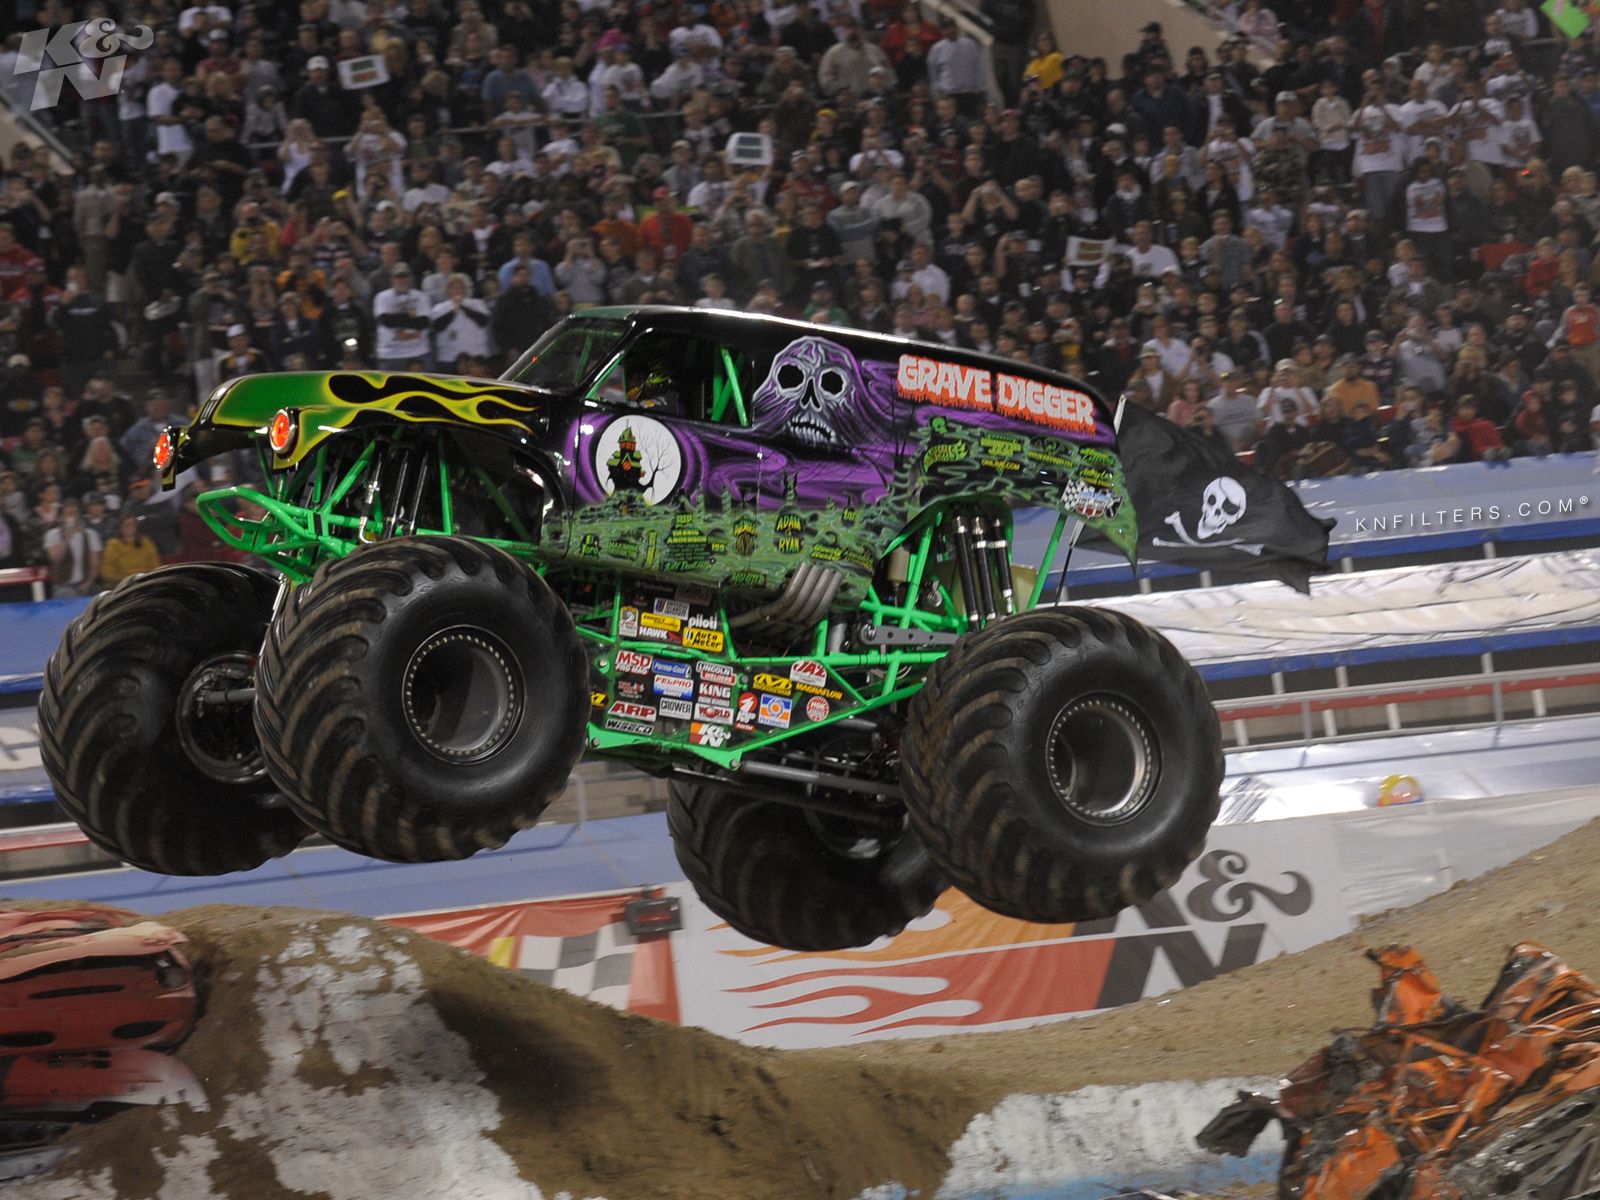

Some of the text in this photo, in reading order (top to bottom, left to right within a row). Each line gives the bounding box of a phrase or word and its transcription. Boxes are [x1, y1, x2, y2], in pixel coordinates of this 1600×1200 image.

[898, 355, 1095, 427] GRAVE DIGGER
[777, 515, 801, 531] ADAM
[779, 537, 800, 553] RYAN
[688, 613, 718, 630] piloti
[639, 626, 668, 640] HAWK
[695, 630, 718, 641] Auto
[692, 638, 722, 649] Meter
[619, 651, 652, 670] MSD
[699, 662, 732, 676] LINCOLN
[793, 660, 825, 678] JAZ
[699, 682, 731, 698] KING
[795, 682, 843, 700] MAGNAFLOW
[611, 703, 655, 717] ARP
[661, 699, 690, 713] CROWER
[699, 706, 730, 718] WORLD
